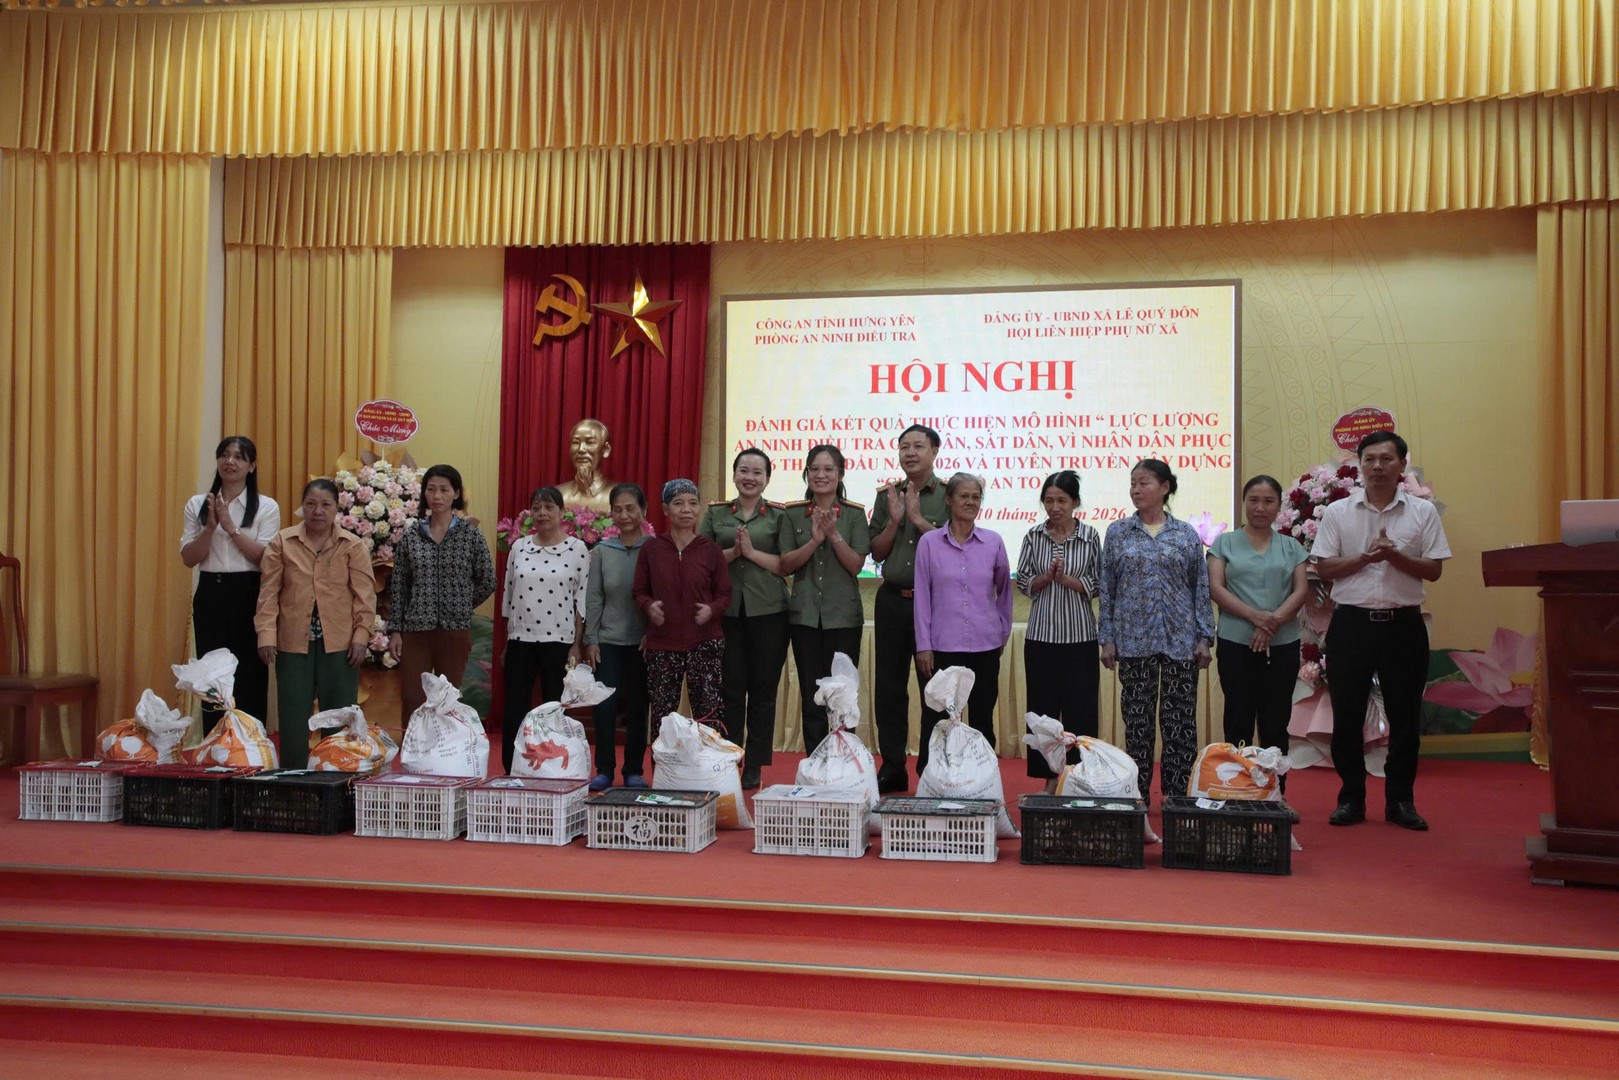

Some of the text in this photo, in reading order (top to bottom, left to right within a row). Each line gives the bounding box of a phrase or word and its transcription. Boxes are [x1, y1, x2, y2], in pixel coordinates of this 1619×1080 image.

[756, 317, 792, 330] CÔNG
[794, 318, 812, 329] AN
[849, 316, 887, 328] HƯNG
[890, 314, 916, 326] YÊN
[984, 310, 1021, 324] ĐẢNG
[1024, 310, 1043, 322] ỦY
[1054, 310, 1090, 322] UBND
[1093, 308, 1112, 321] XÃ
[1116, 306, 1134, 320] LÊ
[1136, 306, 1166, 321] QUÝ
[1170, 306, 1200, 320] ĐÔN
[754, 332, 799, 345] PHÒNG
[802, 333, 819, 344] AN
[822, 332, 853, 344] NINH
[890, 332, 916, 342] TRA
[1006, 322, 1178, 340] HỘI LIÊN HIỆP PHỤ NỮ XÃ
[868, 358, 1077, 402] HỘI NGHỊ
[360, 420, 380, 432] Chúc
[745, 416, 792, 432] ĐÁNH
[796, 415, 826, 431] GIÁ
[832, 414, 866, 430] KẾT
[870, 413, 906, 434] QUẢ
[964, 414, 1006, 432] HIỆN
[1011, 412, 1041, 428] MÔ
[1046, 412, 1092, 428] HÌNH
[1109, 412, 1148, 430] LỰC
[1152, 411, 1219, 430] LƯỢNG
[734, 439, 758, 452] AN
[762, 440, 802, 452] NINH
[852, 438, 886, 450] TRA
[939, 432, 972, 451] ÂN,
[975, 432, 1008, 450] SÁT
[1012, 432, 1054, 450] DÂN,
[1058, 432, 1076, 449] VÌ
[1082, 430, 1133, 449] NHÂN
[1138, 430, 1176, 448] DÂN
[1181, 434, 1232, 450] PHỤC
[1336, 432, 1359, 444] Chúc
[934, 456, 960, 470] 026
[965, 454, 988, 470] VÀ
[993, 452, 1053, 470] TUYÊN
[1057, 452, 1130, 469] TRUYỀN
[1178, 453, 1232, 472] DỰNG
[990, 476, 1013, 490] AN
[997, 507, 1038, 522] tháng
[1092, 507, 1127, 520] 2026
